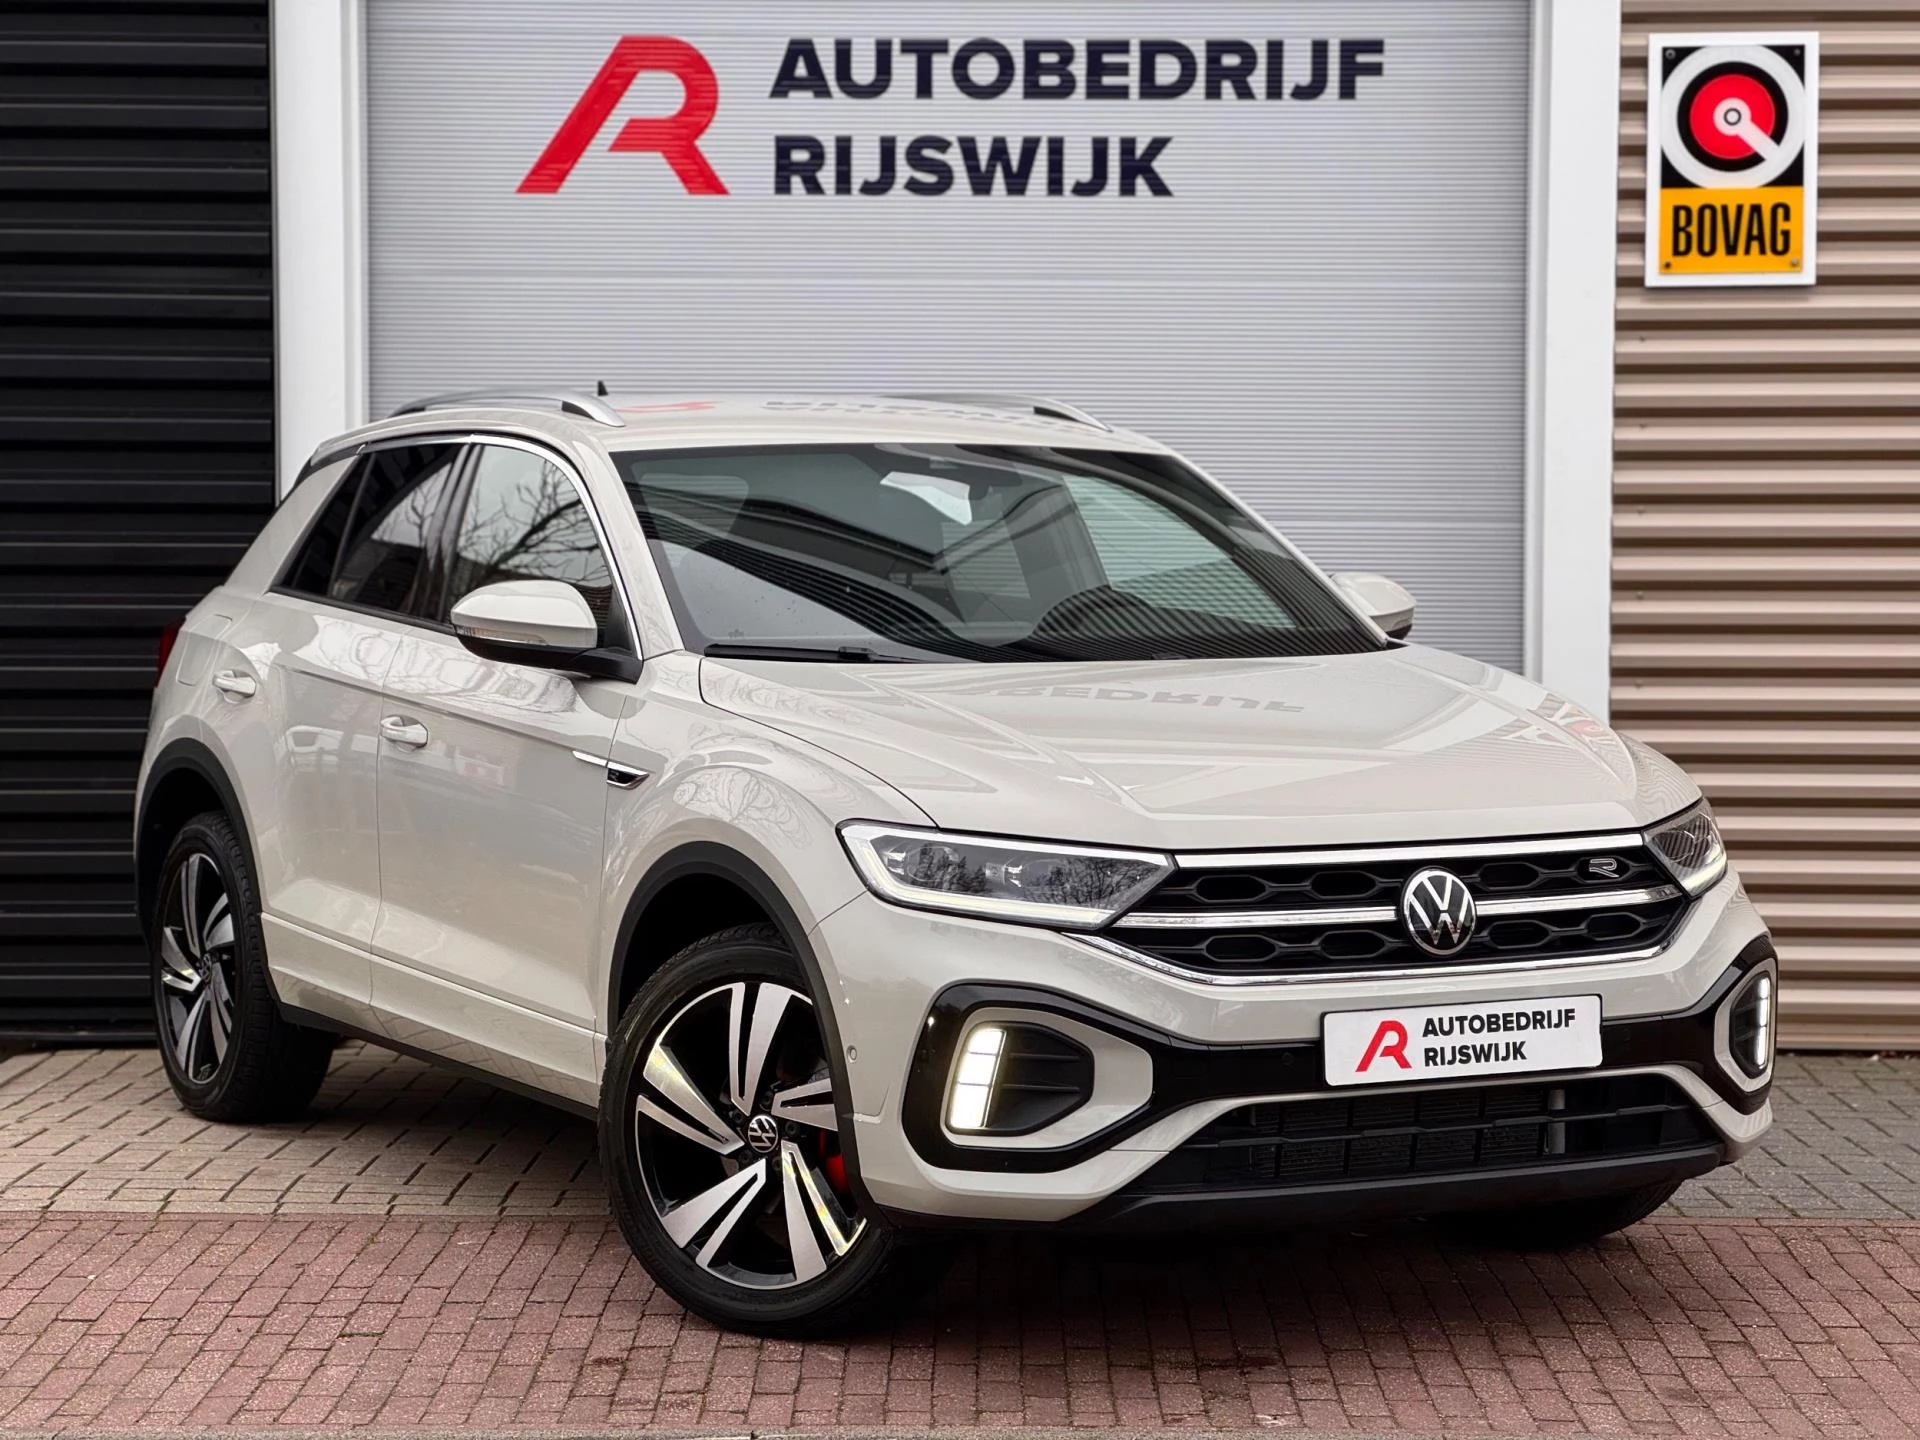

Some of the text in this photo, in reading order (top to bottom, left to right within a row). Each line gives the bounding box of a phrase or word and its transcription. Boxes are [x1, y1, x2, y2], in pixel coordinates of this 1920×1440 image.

[770, 37, 1385, 101] AUTOBEDRIJF
[774, 135, 1173, 197] RIJSWIJK
[1671, 202, 1791, 257] BOVAG
[1422, 1008, 1576, 1038] AUTOBEDRIJF
[1424, 1041, 1527, 1067] RIJSWIJK
